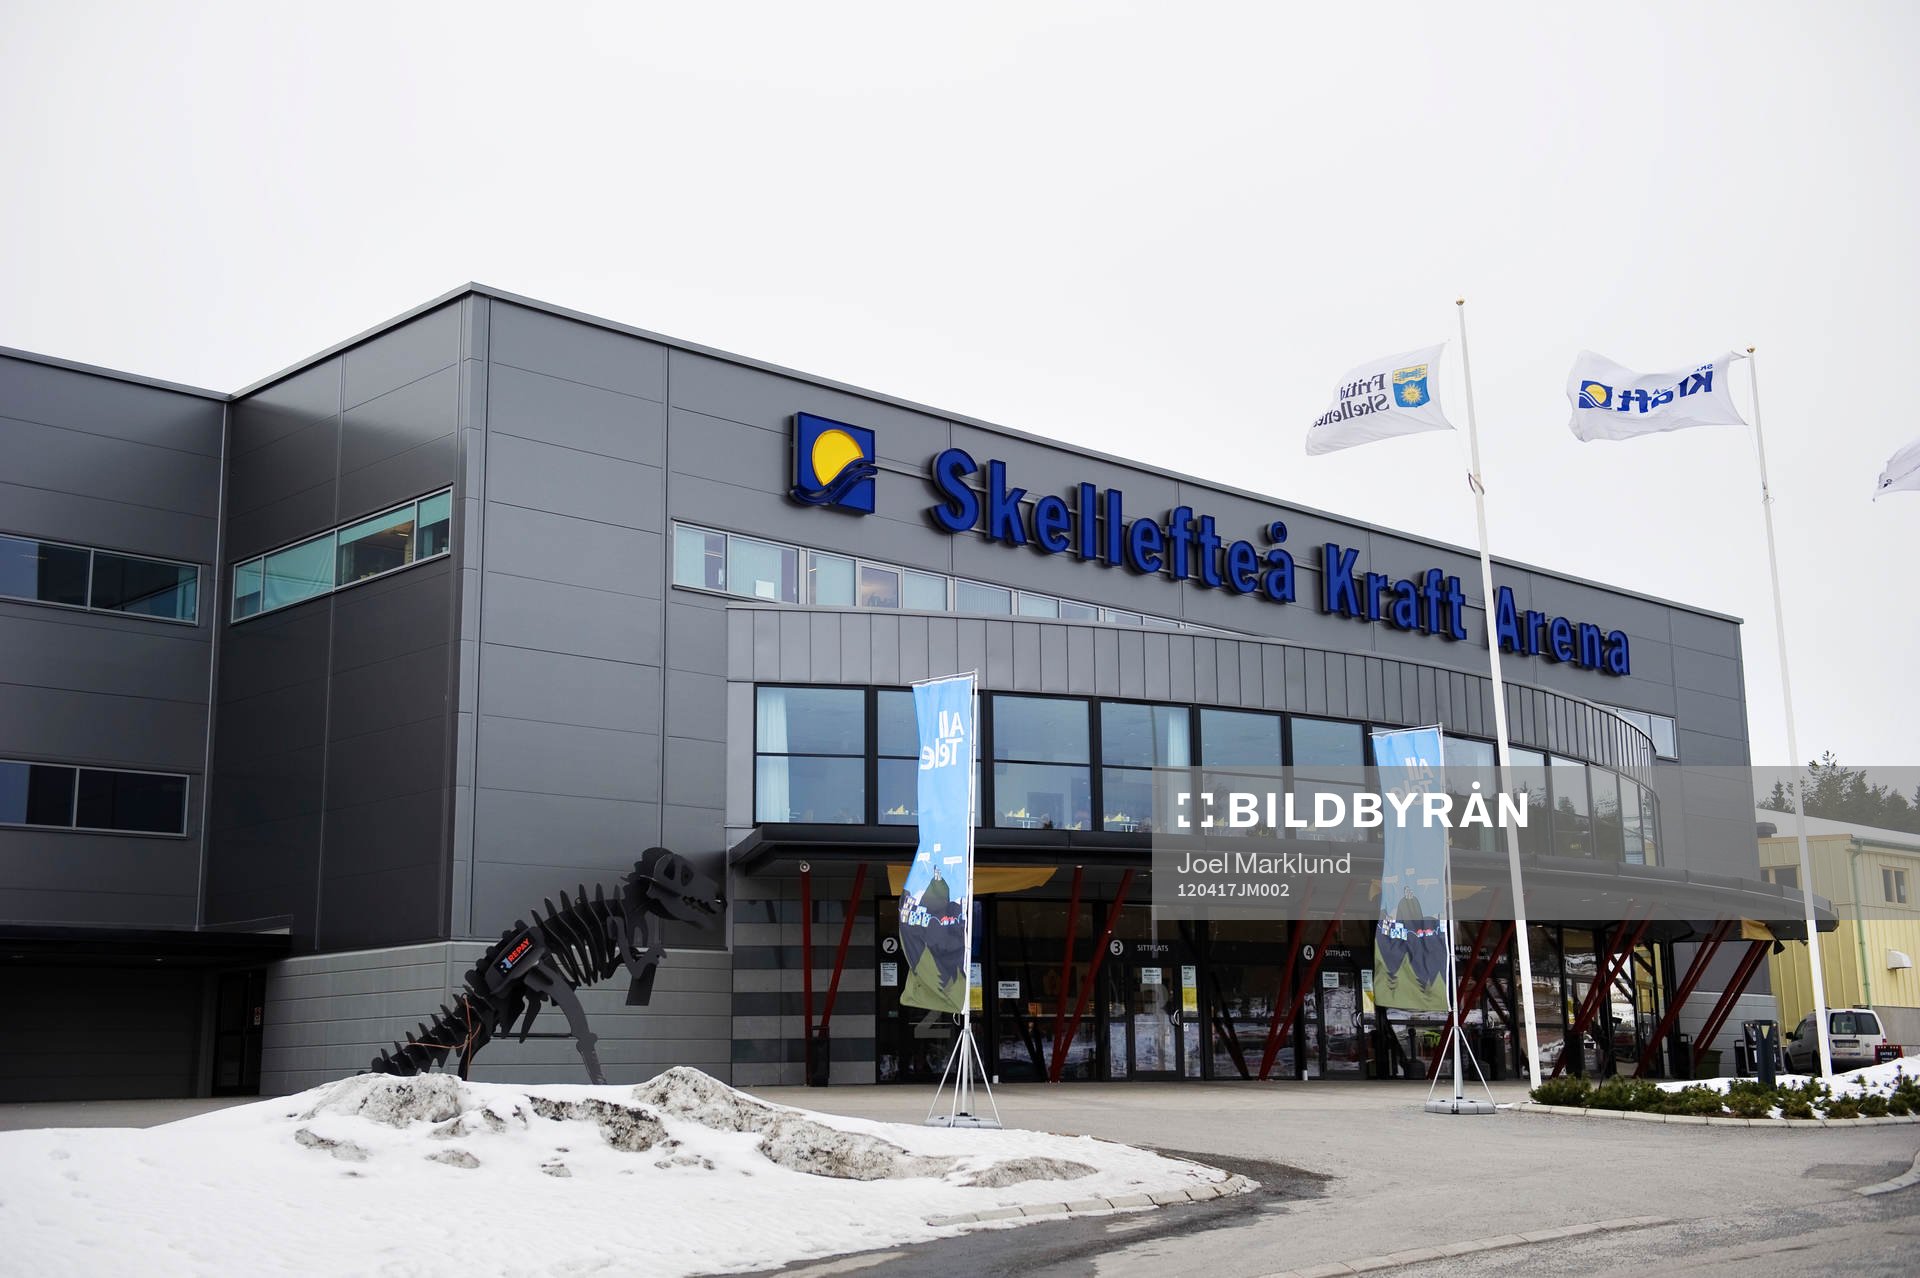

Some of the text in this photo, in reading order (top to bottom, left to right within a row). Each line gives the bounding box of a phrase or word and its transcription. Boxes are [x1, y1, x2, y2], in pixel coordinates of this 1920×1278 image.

[931, 447, 1631, 676] Skellefteå Kraft Arena
